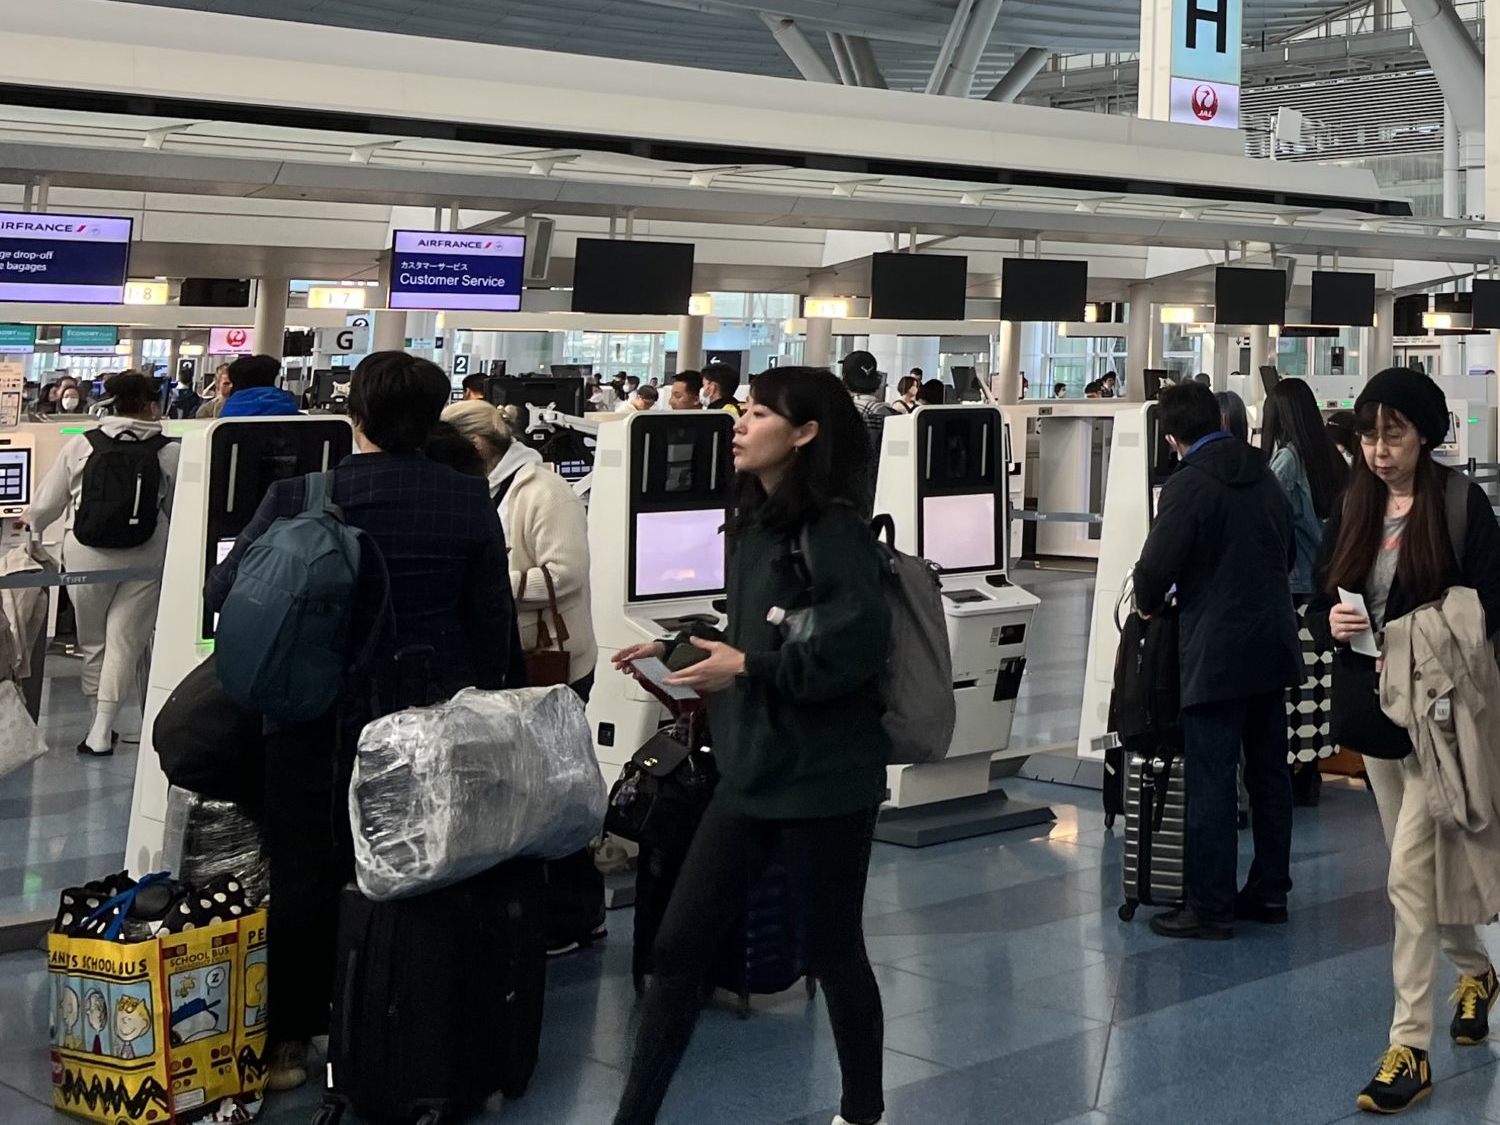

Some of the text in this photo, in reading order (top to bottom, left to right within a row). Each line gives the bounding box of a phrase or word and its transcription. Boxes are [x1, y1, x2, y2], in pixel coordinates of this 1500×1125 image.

[1197, 109, 1213, 118] JAL
[417, 239, 482, 249] AIRFRANCE
[13, 250, 55, 261] drop-off
[7, 260, 47, 273] bagages
[400, 260, 468, 271] カスタマーサービス
[400, 273, 506, 287] Customer Service
[336, 330, 354, 351] G
[455, 356, 467, 373] 2
[169, 951, 210, 967] SCHOOL
[212, 946, 230, 957] BUS
[82, 955, 117, 974] SCHOOL
[118, 958, 148, 975] BUS
[211, 973, 220, 984] Z
